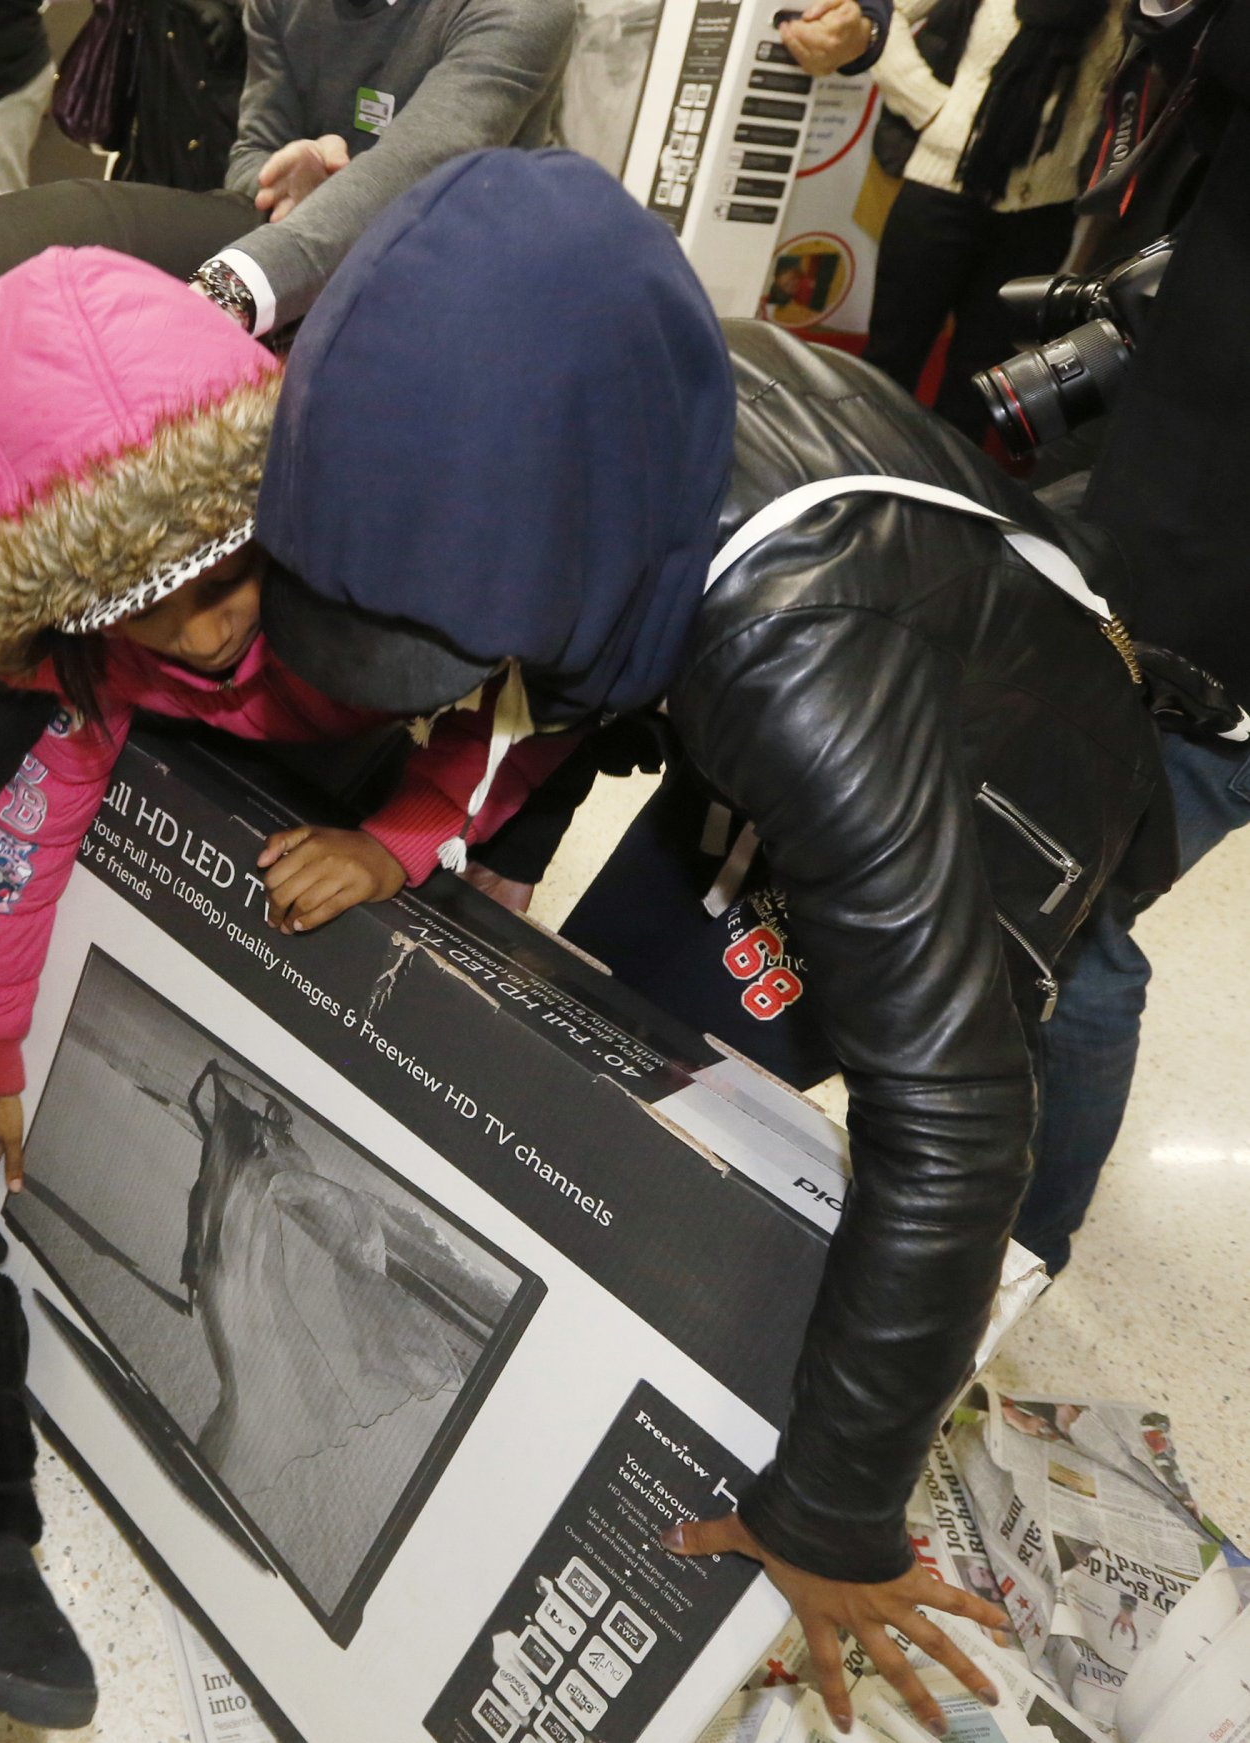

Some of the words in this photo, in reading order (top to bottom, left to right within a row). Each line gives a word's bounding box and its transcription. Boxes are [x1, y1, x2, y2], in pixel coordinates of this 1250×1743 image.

[81, 834, 95, 856] ly
[95, 846, 106, 863] &
[107, 855, 152, 901] friends
[135, 796, 179, 847] HD
[181, 829, 236, 889] LED
[244, 872, 270, 922] T
[409, 924, 445, 949] TV
[448, 949, 498, 982] LED
[497, 981, 540, 1012] HD
[94, 816, 122, 847] ious
[123, 838, 148, 868] Full
[149, 857, 173, 886] HD
[172, 877, 227, 930] (1080p)
[226, 921, 281, 971] quality
[281, 960, 341, 1017] images
[343, 1009, 357, 1028] &
[359, 1018, 443, 1093] Freeview
[444, 1084, 478, 1120] HD
[484, 1112, 515, 1145] TV
[514, 1143, 614, 1227] channels
[541, 1011, 592, 1046] Full
[558, 1004, 614, 1043] glorious
[614, 1043, 656, 1073] Enjoy
[634, 1409, 710, 1479] Freeview
[607, 1482, 621, 1497] HD
[621, 1494, 649, 1526] movies,
[618, 1466, 674, 1520] television
[625, 1452, 652, 1482] Your
[653, 1479, 700, 1524] favourit
[616, 1503, 629, 1516] TV
[627, 1514, 650, 1538] series
[935, 1504, 966, 1552] Jolly
[940, 1473, 988, 1557] Richard
[586, 1519, 602, 1535] and
[601, 1533, 639, 1569] enhanced
[637, 1565, 661, 1590] audio
[659, 1586, 685, 1613] clarity
[588, 1506, 600, 1520] Up
[600, 1517, 610, 1529] to
[616, 1532, 637, 1556] times
[636, 1553, 666, 1582] sharper
[664, 1580, 694, 1608] picture
[564, 1524, 583, 1544] Over
[582, 1541, 595, 1555] 50
[593, 1553, 627, 1586] standard
[625, 1584, 651, 1610] digital
[649, 1608, 685, 1643] channels
[616, 1622, 640, 1646] TWO
[202, 1673, 236, 1692] Inv
[208, 1694, 247, 1716] into
